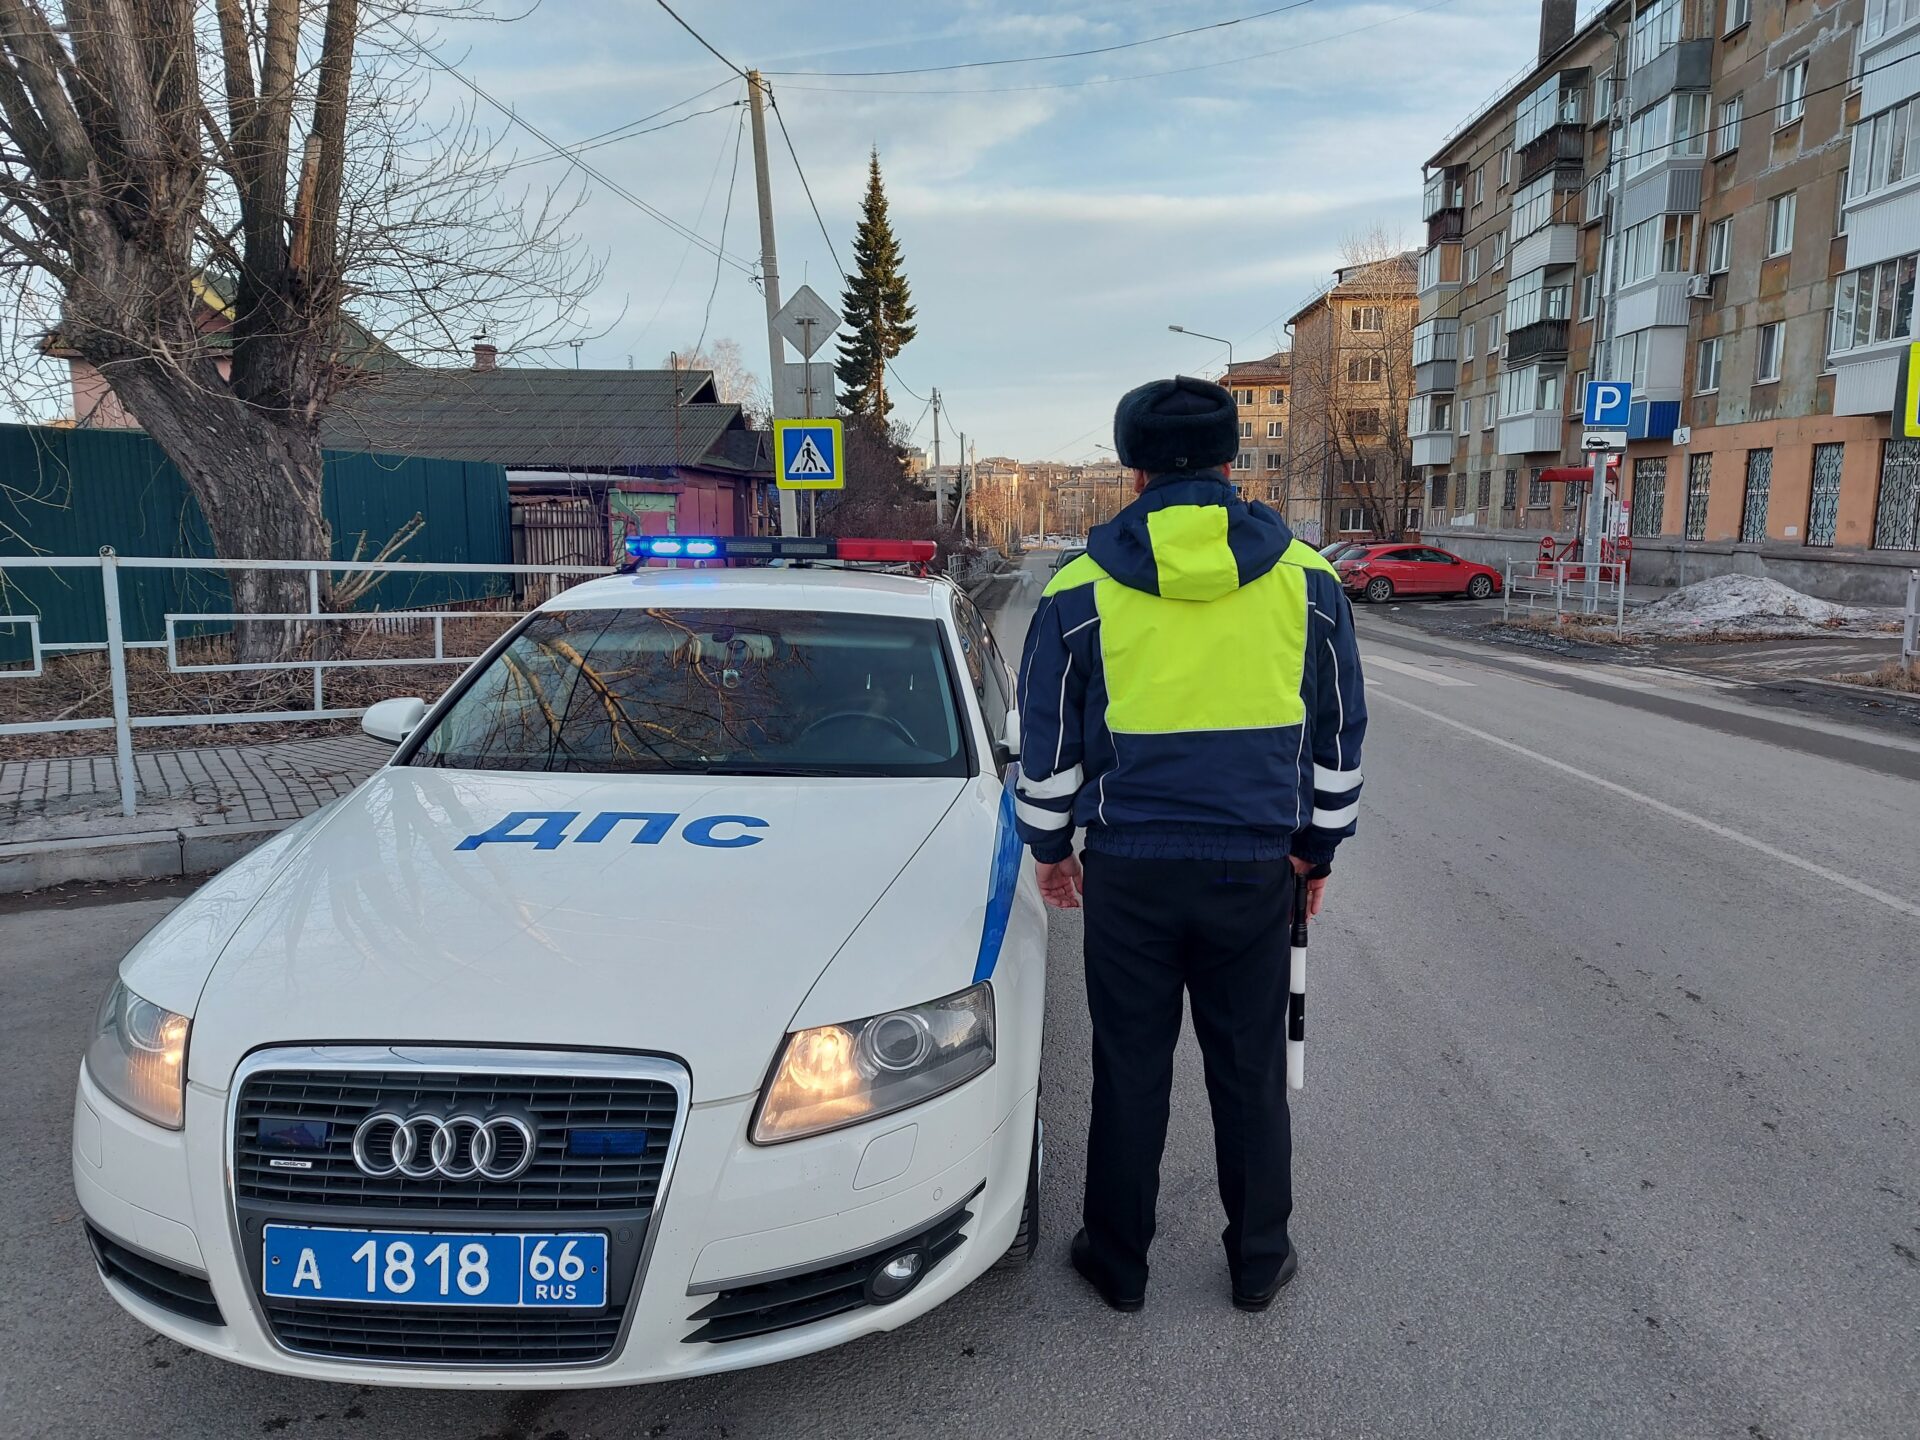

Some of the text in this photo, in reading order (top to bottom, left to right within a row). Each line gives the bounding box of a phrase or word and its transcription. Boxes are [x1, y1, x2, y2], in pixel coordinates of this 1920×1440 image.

[1594, 386, 1621, 421] P
[453, 811, 770, 851] ДПС
[351, 1240, 490, 1296] 1818
[528, 1240, 585, 1282] 66
[535, 1284, 577, 1300] RUS
